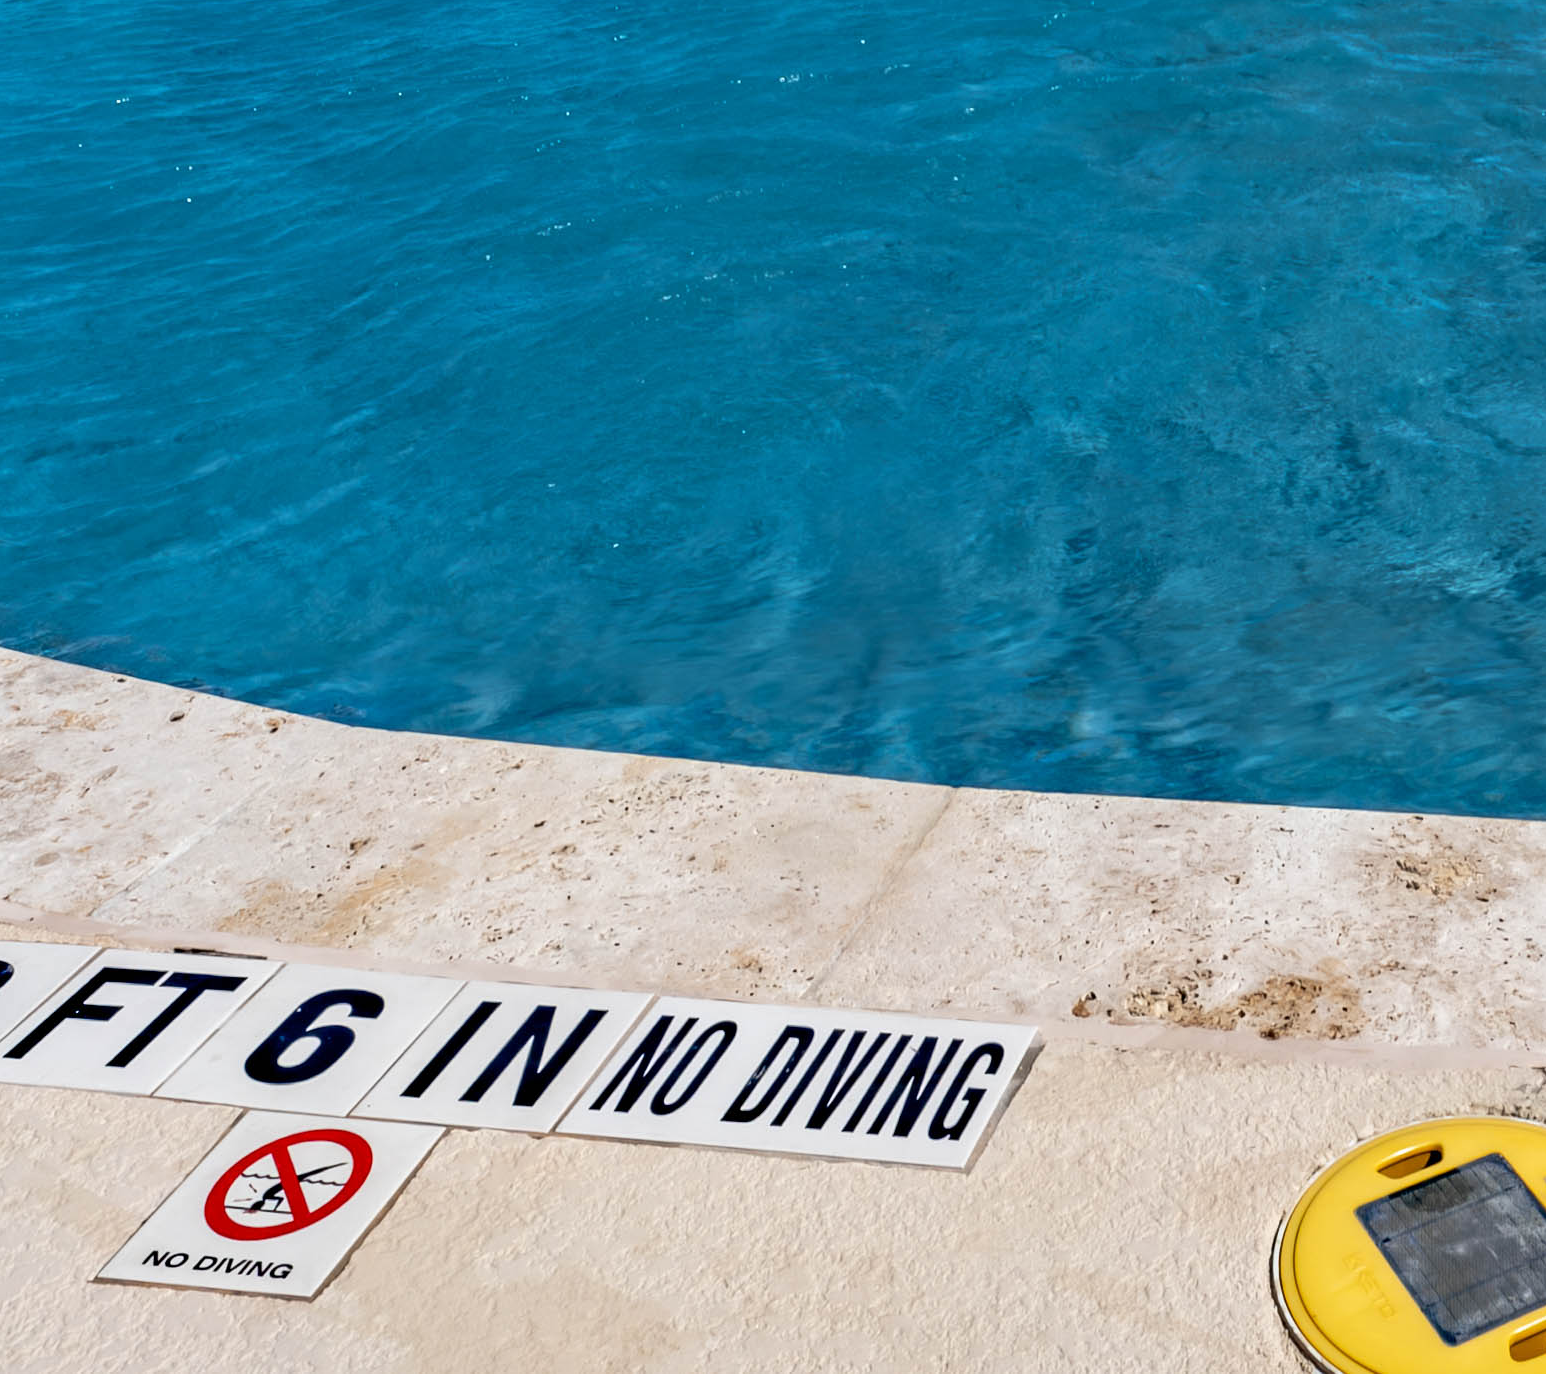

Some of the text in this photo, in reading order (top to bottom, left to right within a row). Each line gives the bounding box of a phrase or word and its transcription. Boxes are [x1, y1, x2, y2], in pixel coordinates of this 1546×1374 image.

[2, 966, 248, 1068] FT
[244, 989, 385, 1085] 6
[399, 1001, 609, 1107] IN
[588, 1015, 738, 1116] NO
[720, 1025, 1005, 1141] DIVING
[141, 1250, 294, 1280] NO DIVING
